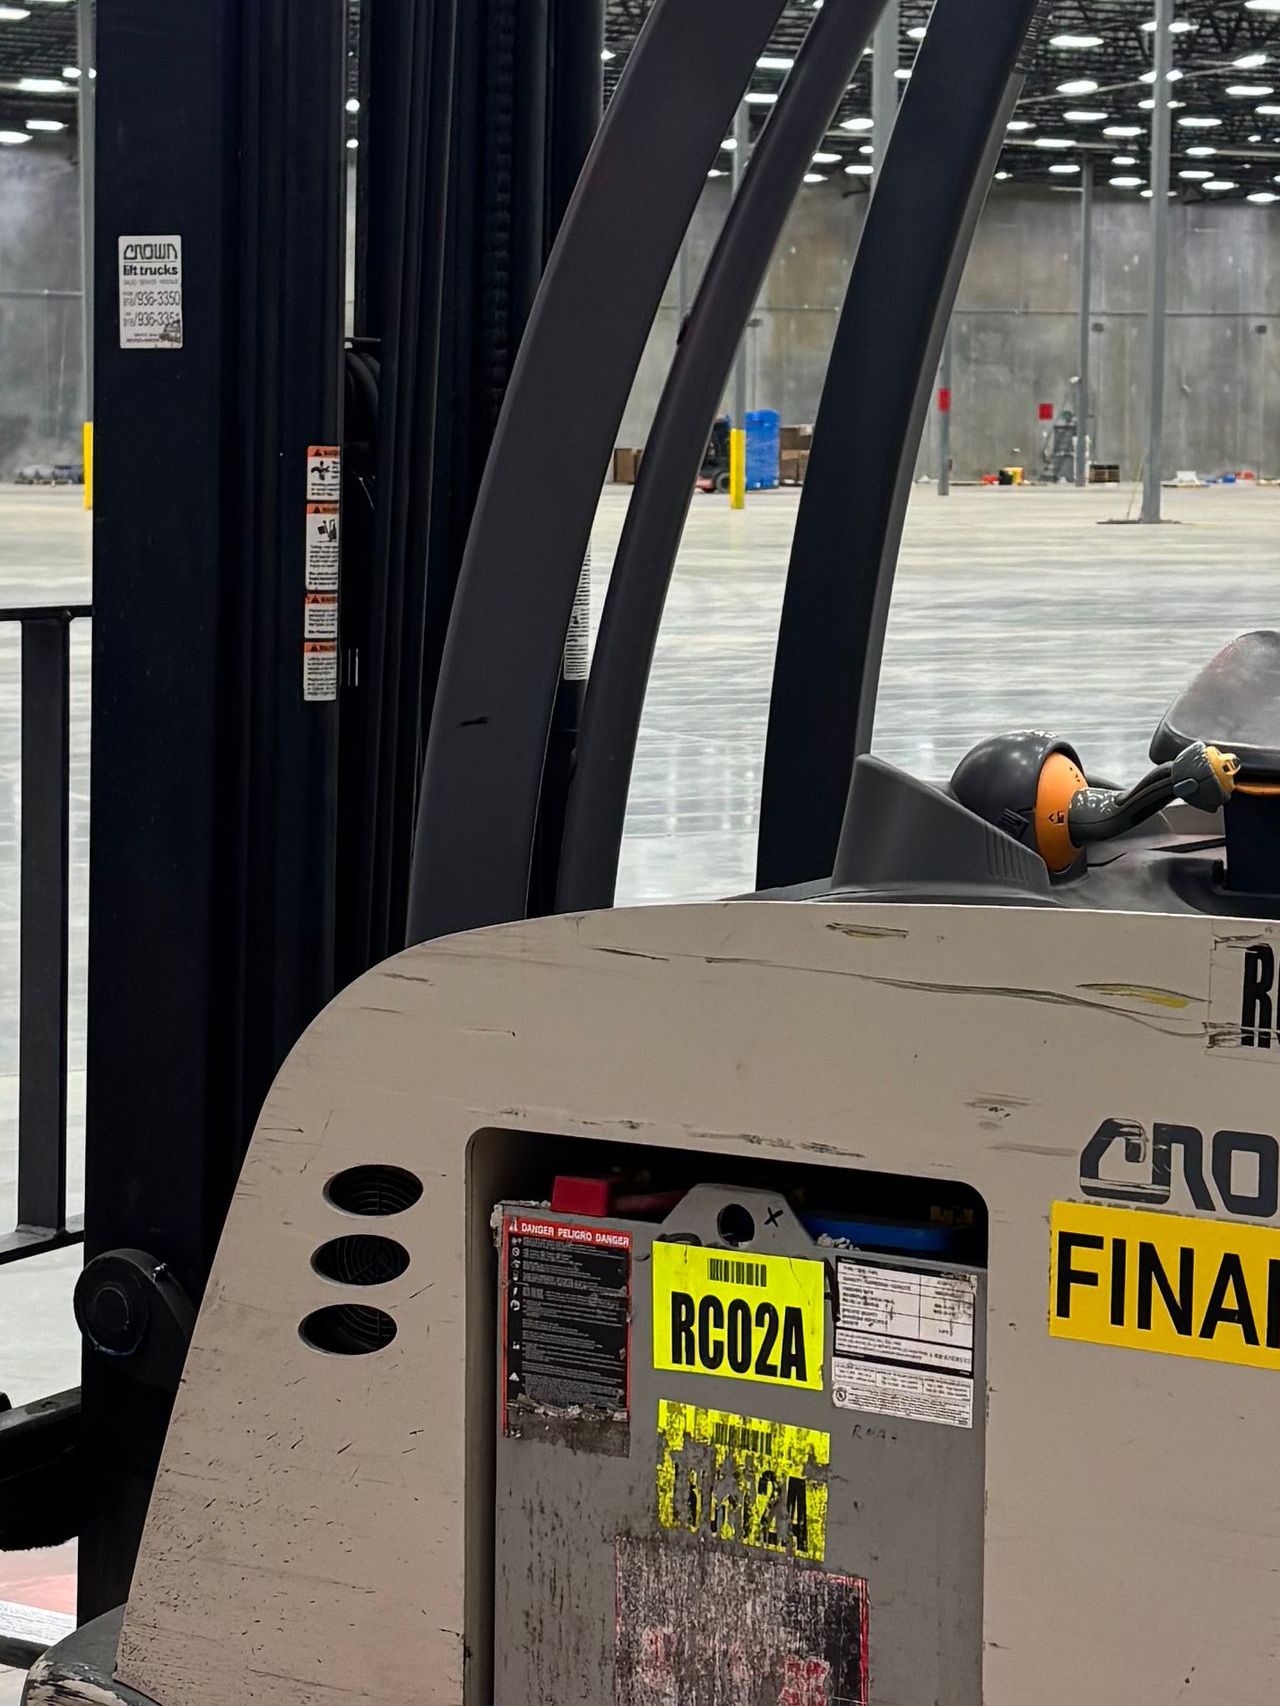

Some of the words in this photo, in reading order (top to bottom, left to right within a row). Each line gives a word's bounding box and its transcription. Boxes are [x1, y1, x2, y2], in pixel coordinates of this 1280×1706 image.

[123, 243, 178, 260] CROWN
[140, 264, 178, 276] trucks
[521, 1223, 554, 1236] DANGER
[557, 1228, 592, 1242] PELIGRO
[595, 1234, 629, 1247] DANGER
[671, 1290, 808, 1382] RC02A
